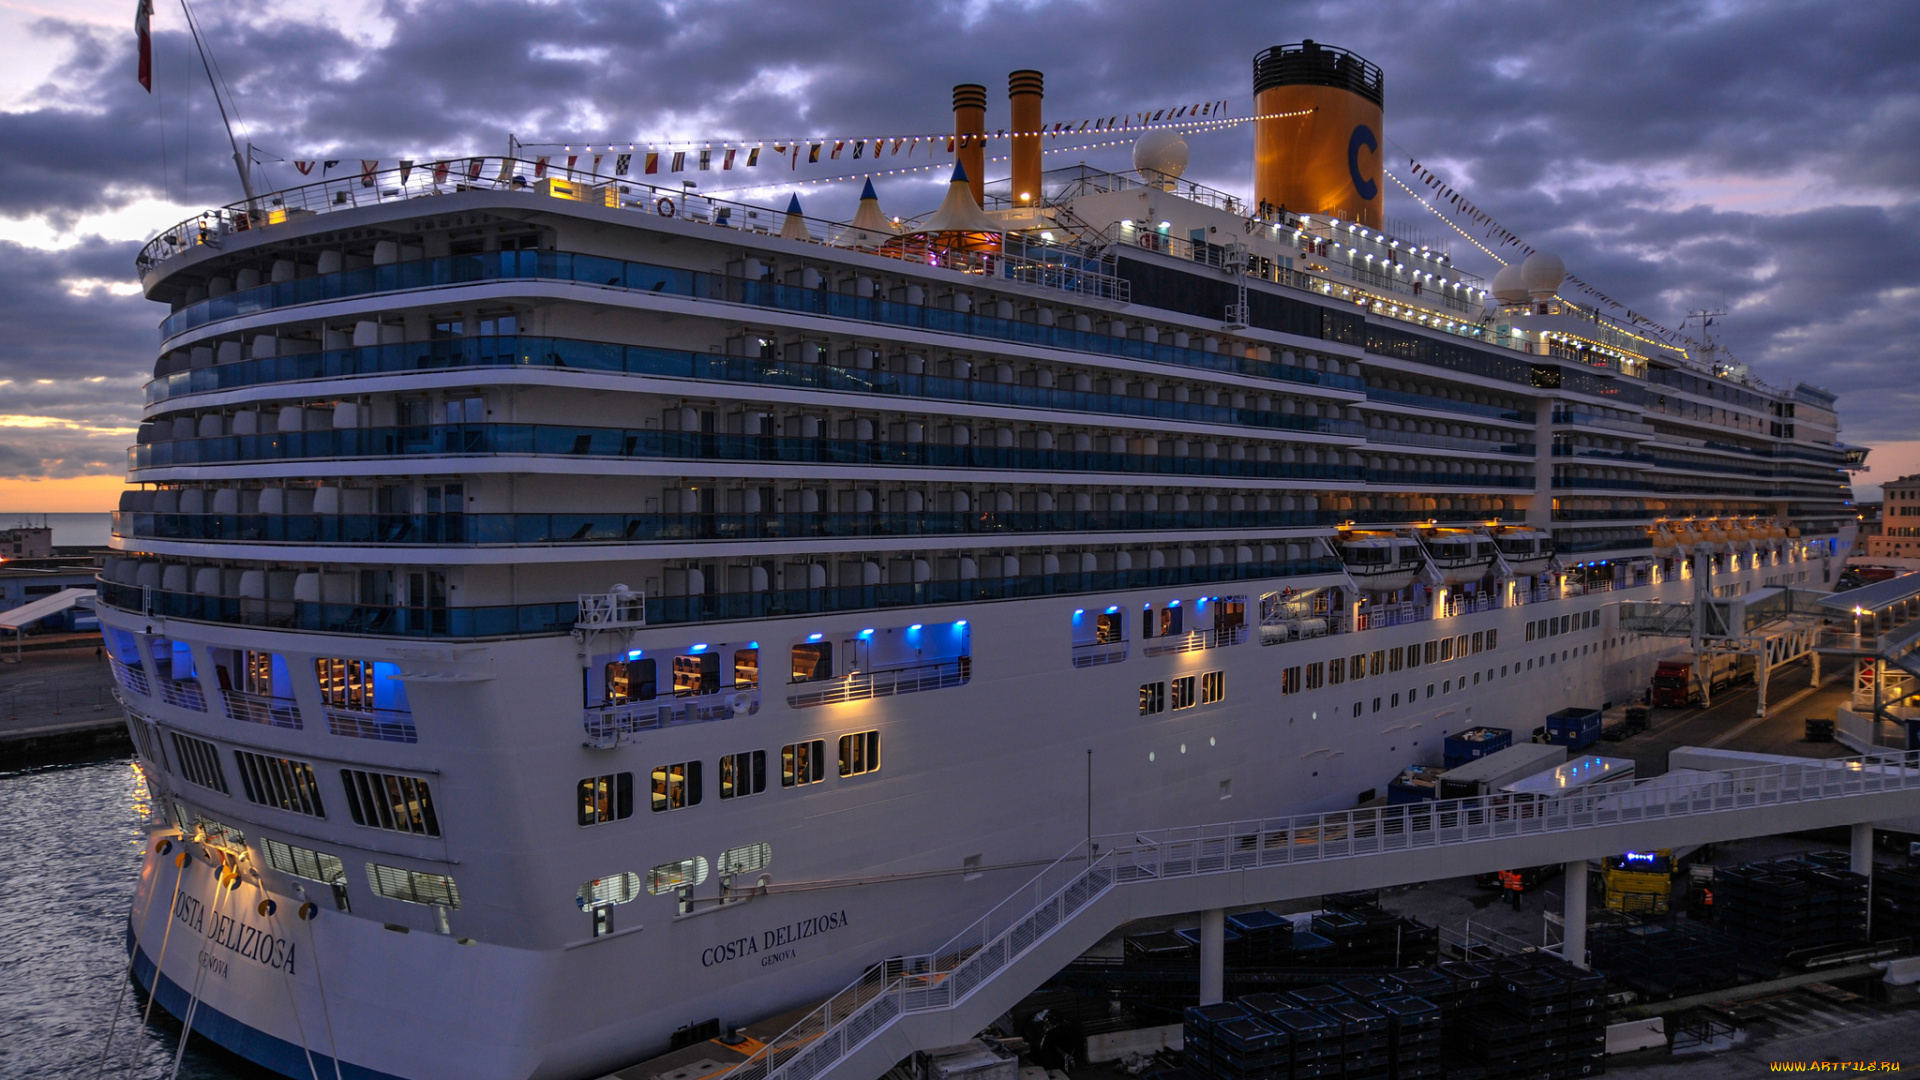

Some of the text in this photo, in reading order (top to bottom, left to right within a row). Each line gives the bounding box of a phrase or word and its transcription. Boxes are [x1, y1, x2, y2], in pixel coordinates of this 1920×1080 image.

[1348, 124, 1378, 201] C
[198, 950, 228, 978] GENOVA
[207, 910, 296, 975] DELIZIOSA
[702, 909, 848, 967] COSTA DELIZIOSA
[761, 949, 796, 967] GENOVA
